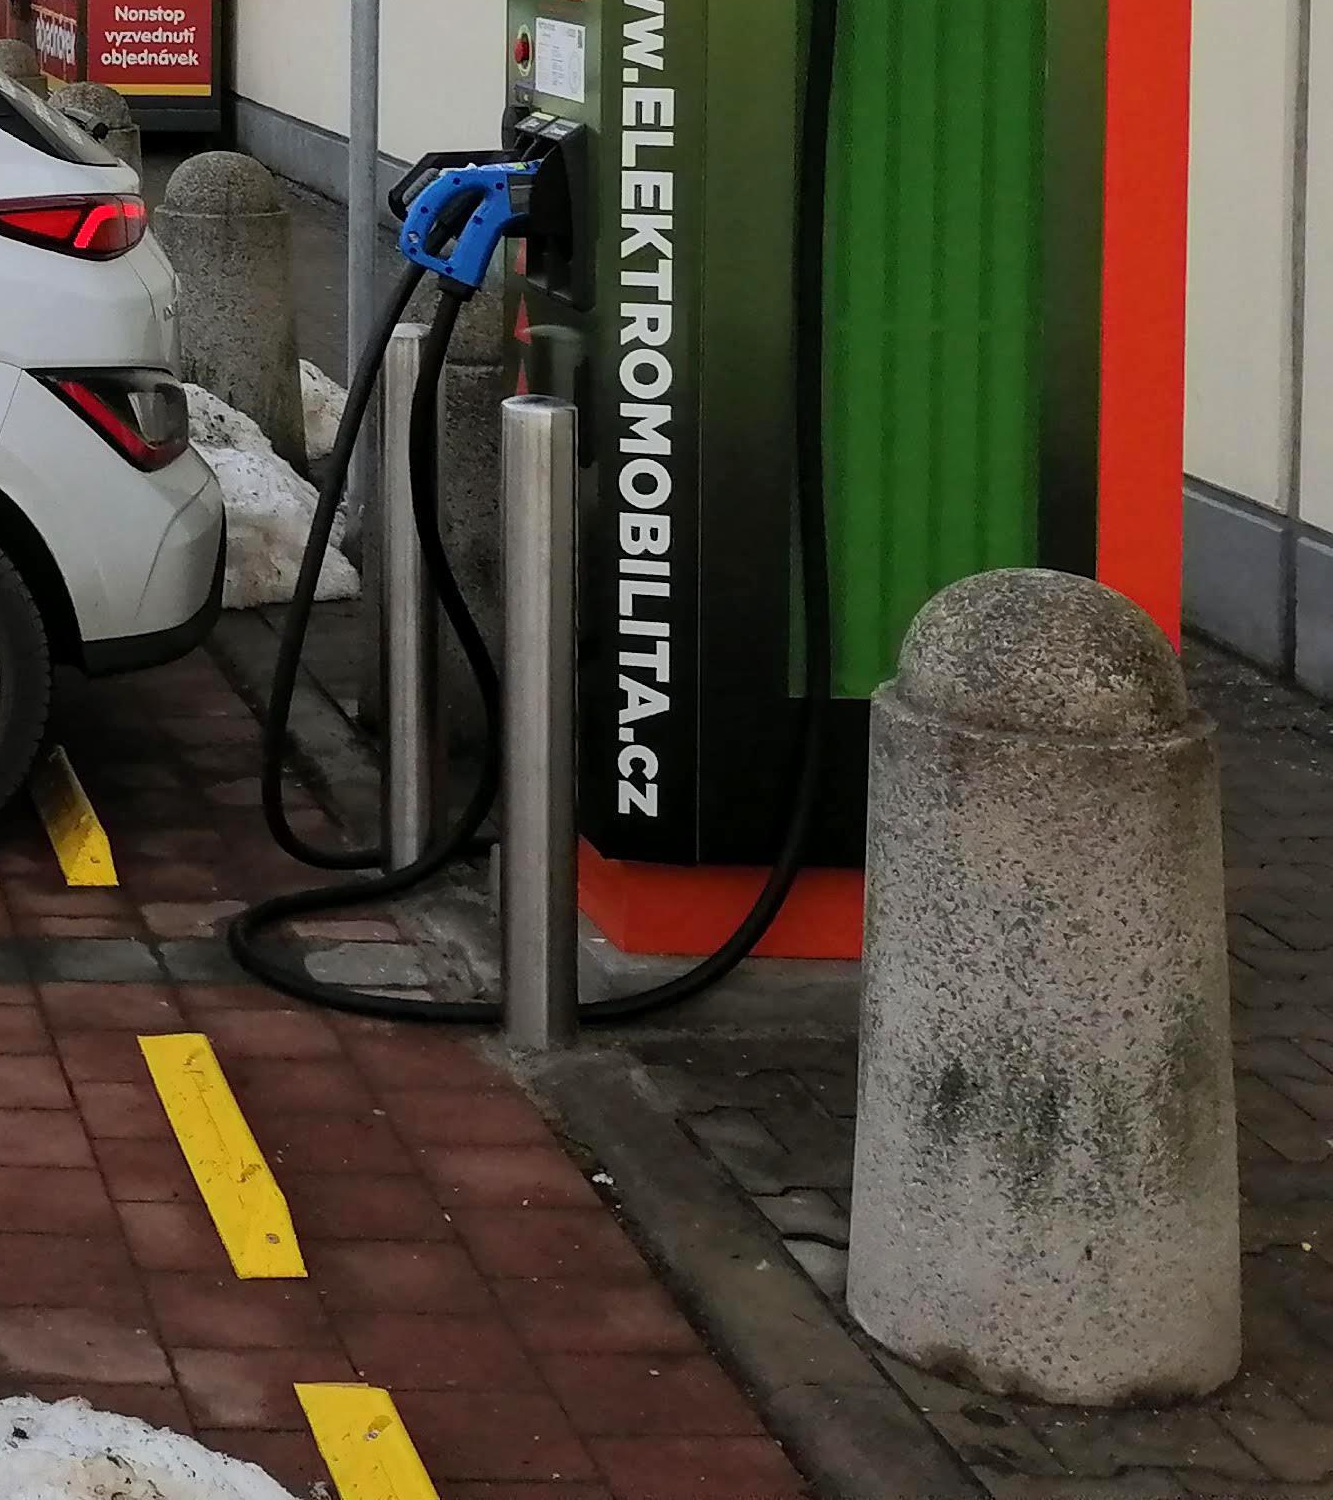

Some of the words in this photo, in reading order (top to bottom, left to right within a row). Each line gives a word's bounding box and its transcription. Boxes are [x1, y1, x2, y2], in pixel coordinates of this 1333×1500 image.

[114, 5, 186, 26] Nonstop
[104, 26, 196, 47] vyzvednutí
[100, 48, 200, 69] objednávek
